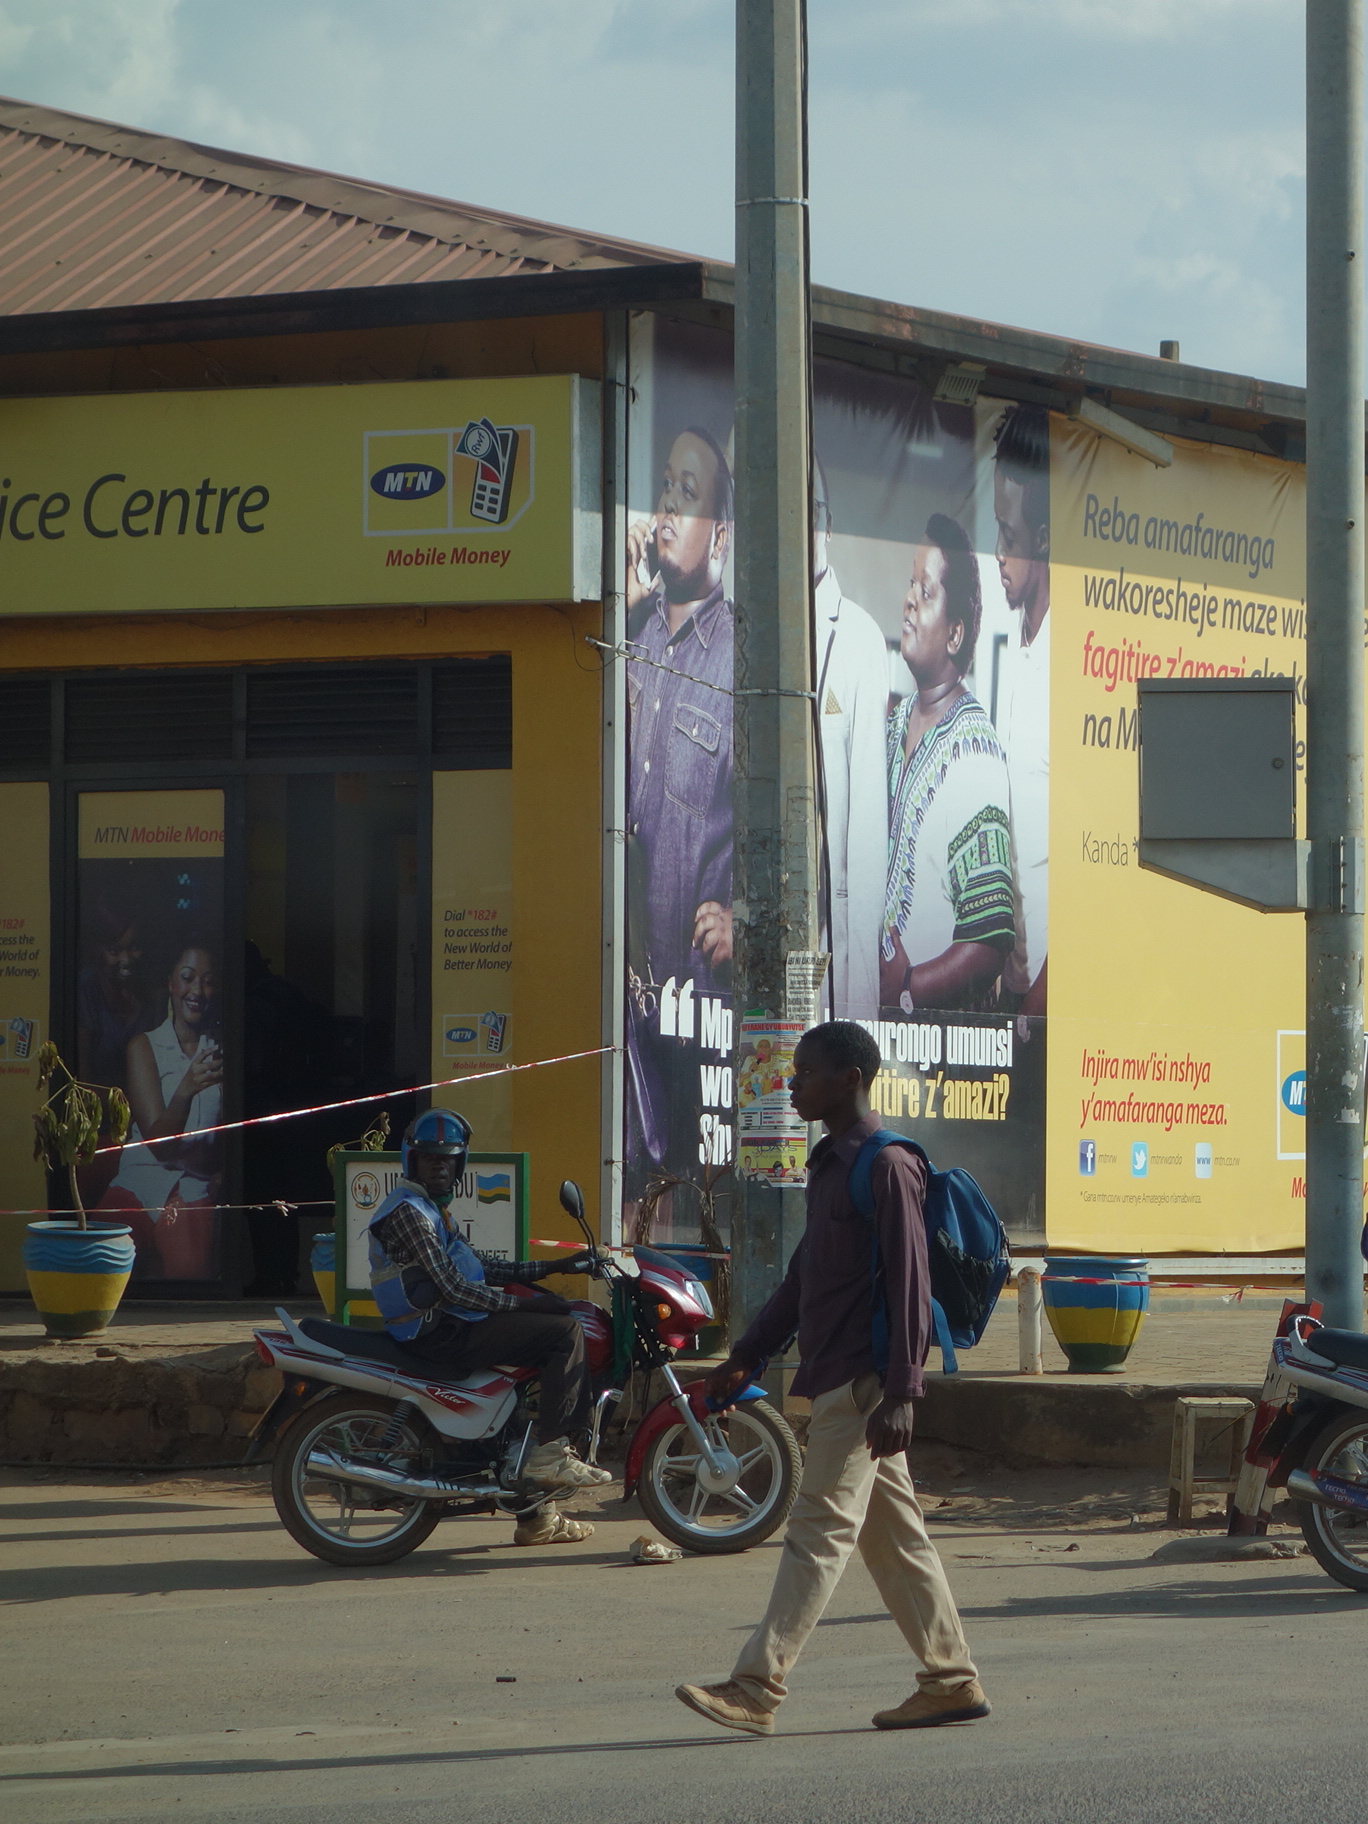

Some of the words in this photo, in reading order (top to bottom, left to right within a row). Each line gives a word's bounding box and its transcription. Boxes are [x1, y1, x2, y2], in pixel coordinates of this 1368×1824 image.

[383, 471, 431, 493] MTN
[83, 473, 270, 539] Centre
[1083, 494, 1139, 545] Reba
[1144, 513, 1275, 579] amafaranga
[385, 548, 446, 568] Mobile
[450, 546, 511, 568] Money
[1083, 566, 1218, 638] wakoresheje
[1222, 599, 1277, 635] maze
[1082, 630, 1161, 692] fagitire
[1082, 710, 1110, 749] na
[94, 827, 129, 843] MTN
[131, 826, 183, 844] Mobile
[1082, 830, 1129, 867] Kanda
[444, 909, 466, 922] Dial
[444, 927, 455, 938] to
[456, 928, 489, 938] access
[491, 925, 508, 937] the
[28, 949, 40, 961] of
[444, 942, 472, 954] New
[469, 941, 500, 953] World
[444, 959, 475, 971] Better
[452, 1030, 472, 1040] MTN
[946, 1020, 1013, 1068] umunsi
[452, 1061, 478, 1070] Mobile
[478, 1061, 504, 1070] Money
[1081, 1049, 1119, 1087] Injira
[1169, 1052, 1212, 1091] nshya
[924, 1071, 1011, 1121] z'amazi?
[1080, 1091, 1184, 1132] y'amafaranga
[1185, 1103, 1228, 1125] meza.
[427, 1386, 466, 1405] Victor
[1324, 1484, 1347, 1494] TECNO
